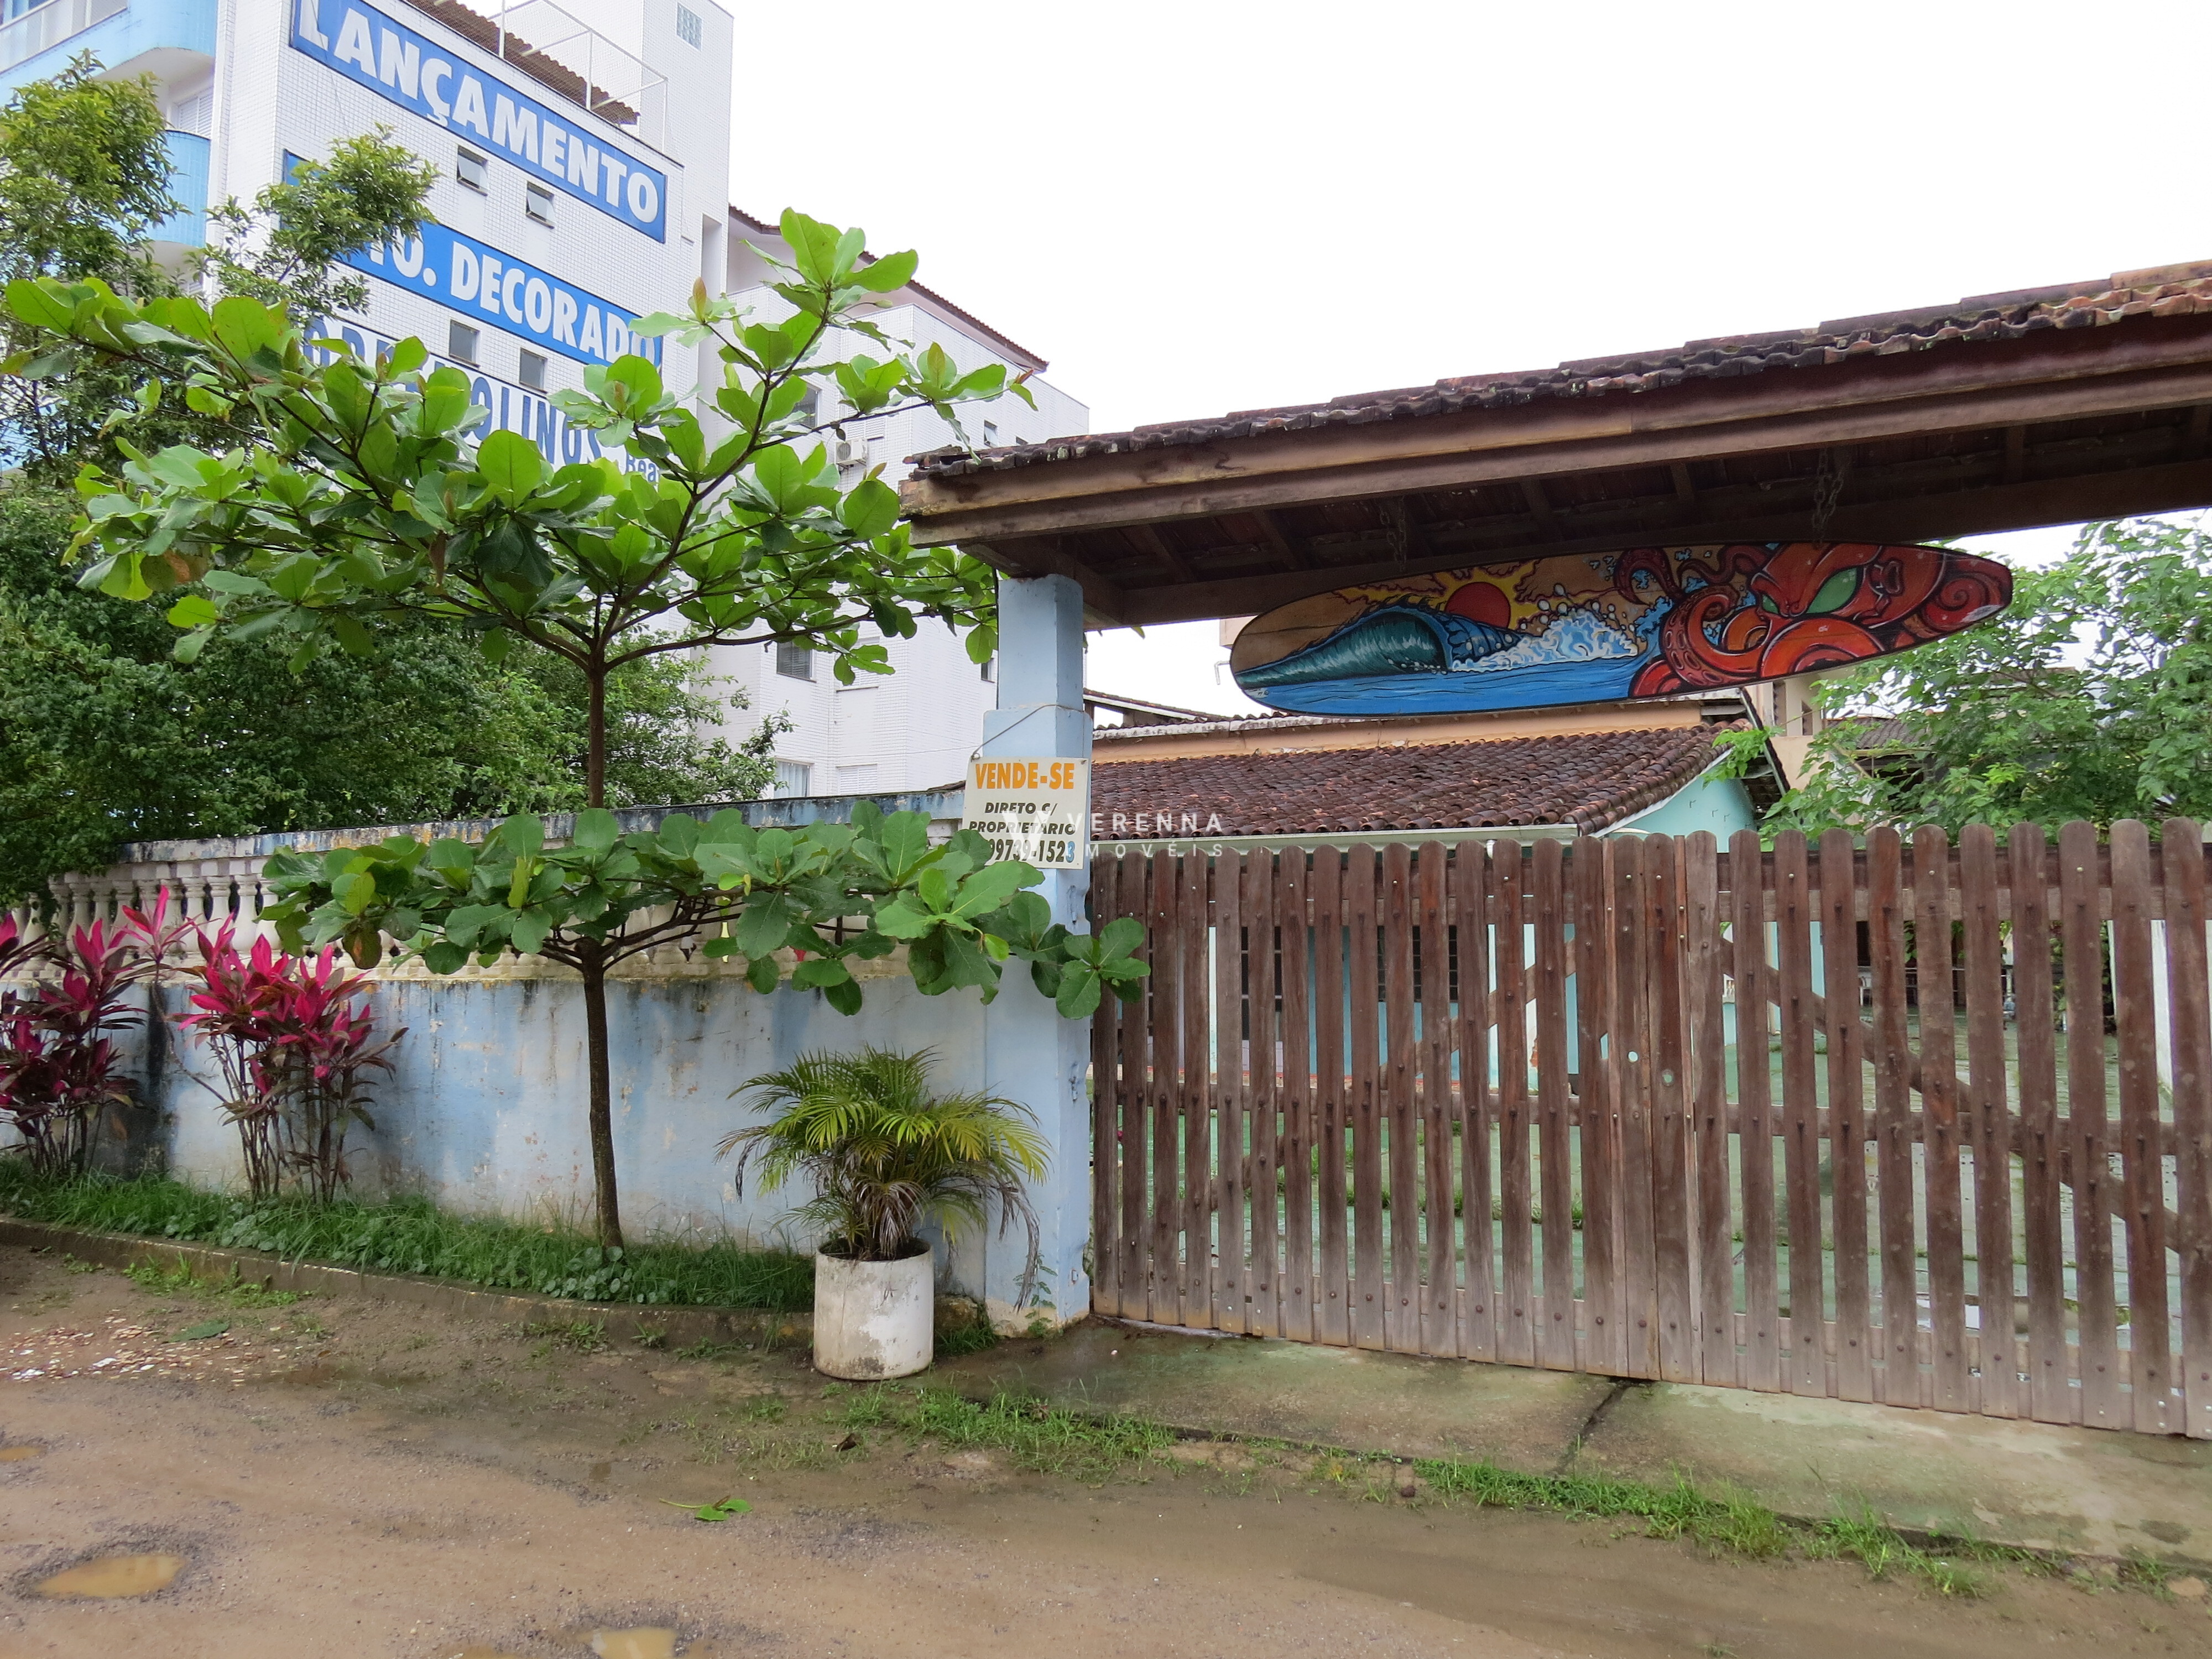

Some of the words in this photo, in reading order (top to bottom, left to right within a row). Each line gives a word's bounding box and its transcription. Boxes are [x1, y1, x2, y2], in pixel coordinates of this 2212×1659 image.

[299, 0, 659, 223] LANÇAMENTO
[450, 241, 655, 365] DECORADO
[975, 762, 1075, 790] VENDE-SE
[984, 802, 1036, 814] DIRETO
[1041, 802, 1058, 816] C/
